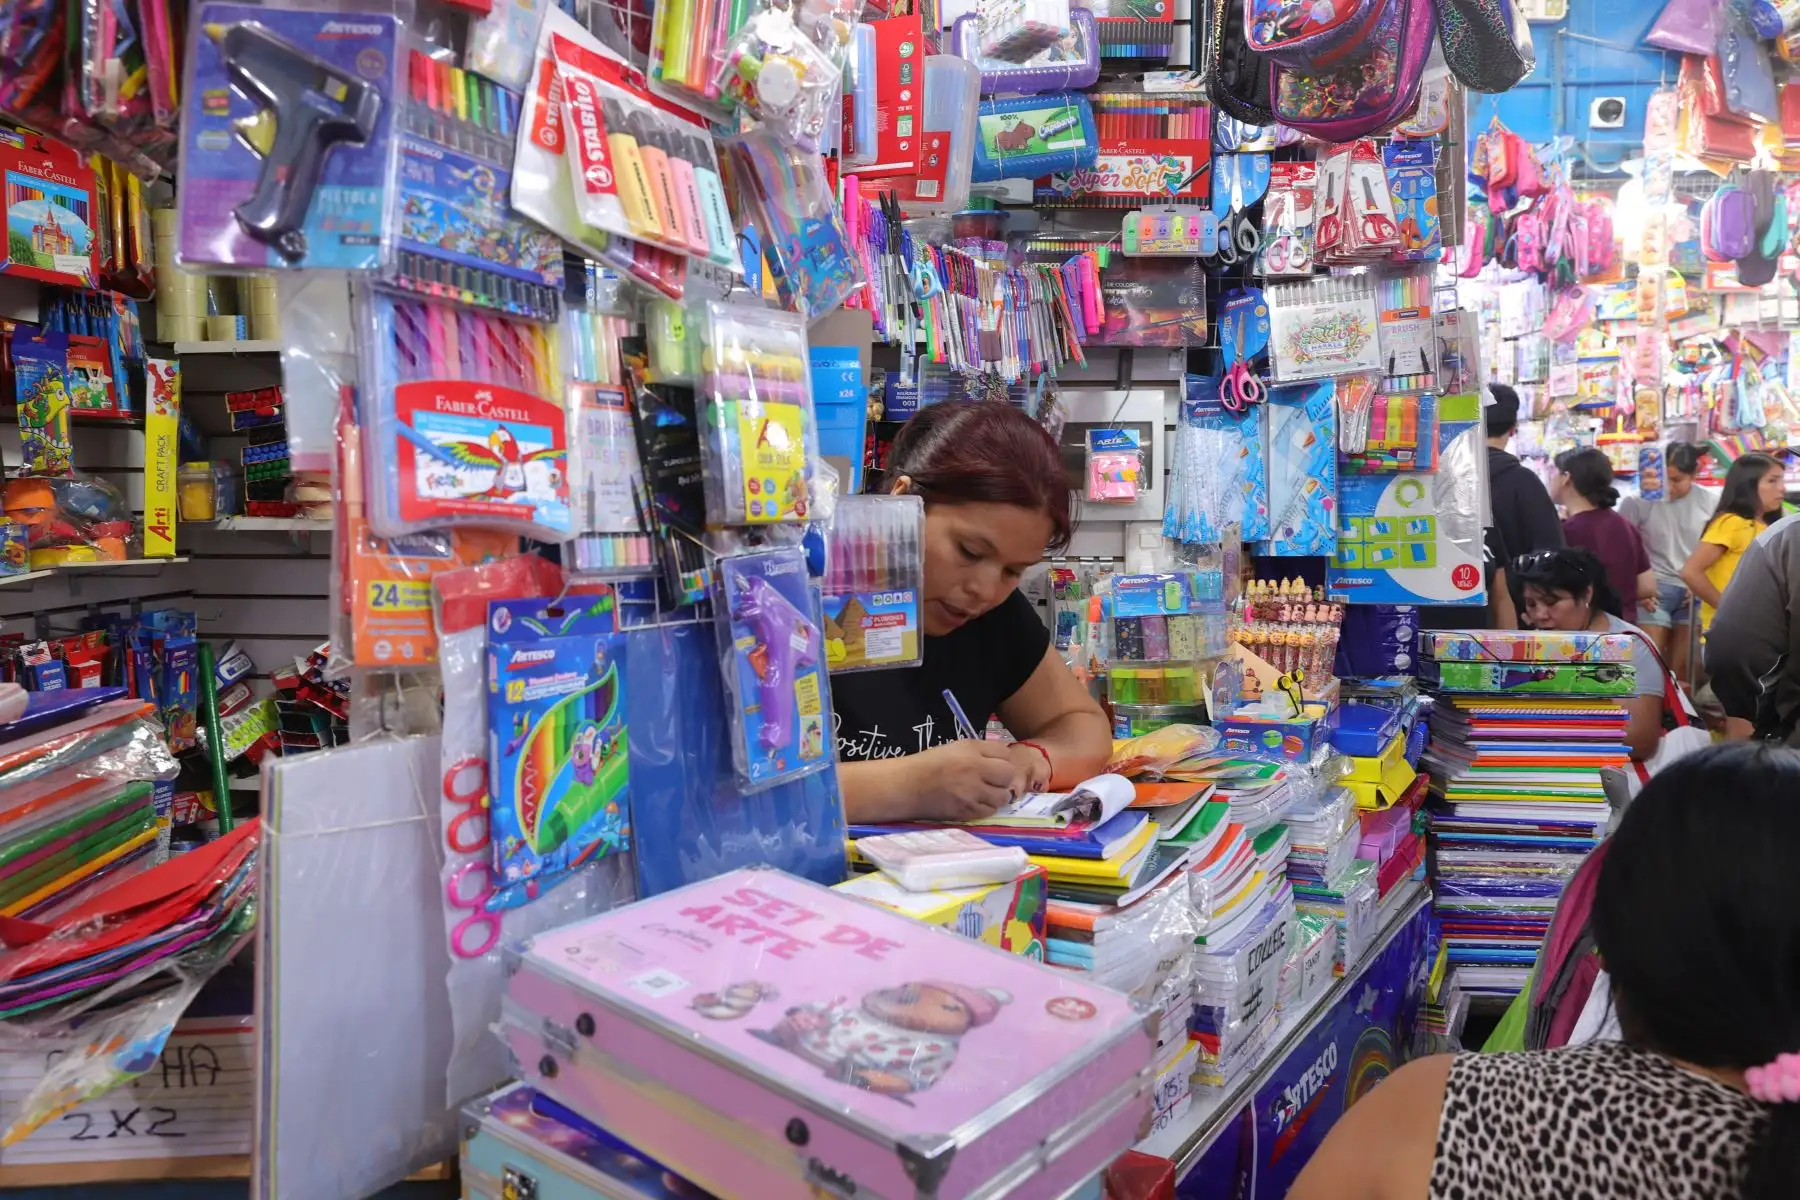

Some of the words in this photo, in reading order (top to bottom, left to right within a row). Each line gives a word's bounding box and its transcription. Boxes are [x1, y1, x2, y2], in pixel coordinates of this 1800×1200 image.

[320, 21, 384, 36] ARTESCO
[1068, 167, 1121, 193] Super
[1121, 163, 1178, 195] Soft
[1226, 296, 1255, 308] ARTESCO
[435, 395, 531, 422] FABER-CASTELL
[156, 434, 167, 459] PACK
[156, 460, 166, 493] CRAFT
[148, 508, 173, 542] Arti
[1335, 576, 1374, 585] ARTESCO
[1460, 567, 1471, 580] 10
[371, 583, 400, 608] 24
[1399, 616, 1412, 626] A4
[509, 650, 556, 664] ARTESCO
[506, 679, 526, 704] 12
[680, 904, 817, 960] ARTE
[721, 887, 825, 927] SET
[820, 923, 905, 962] DE
